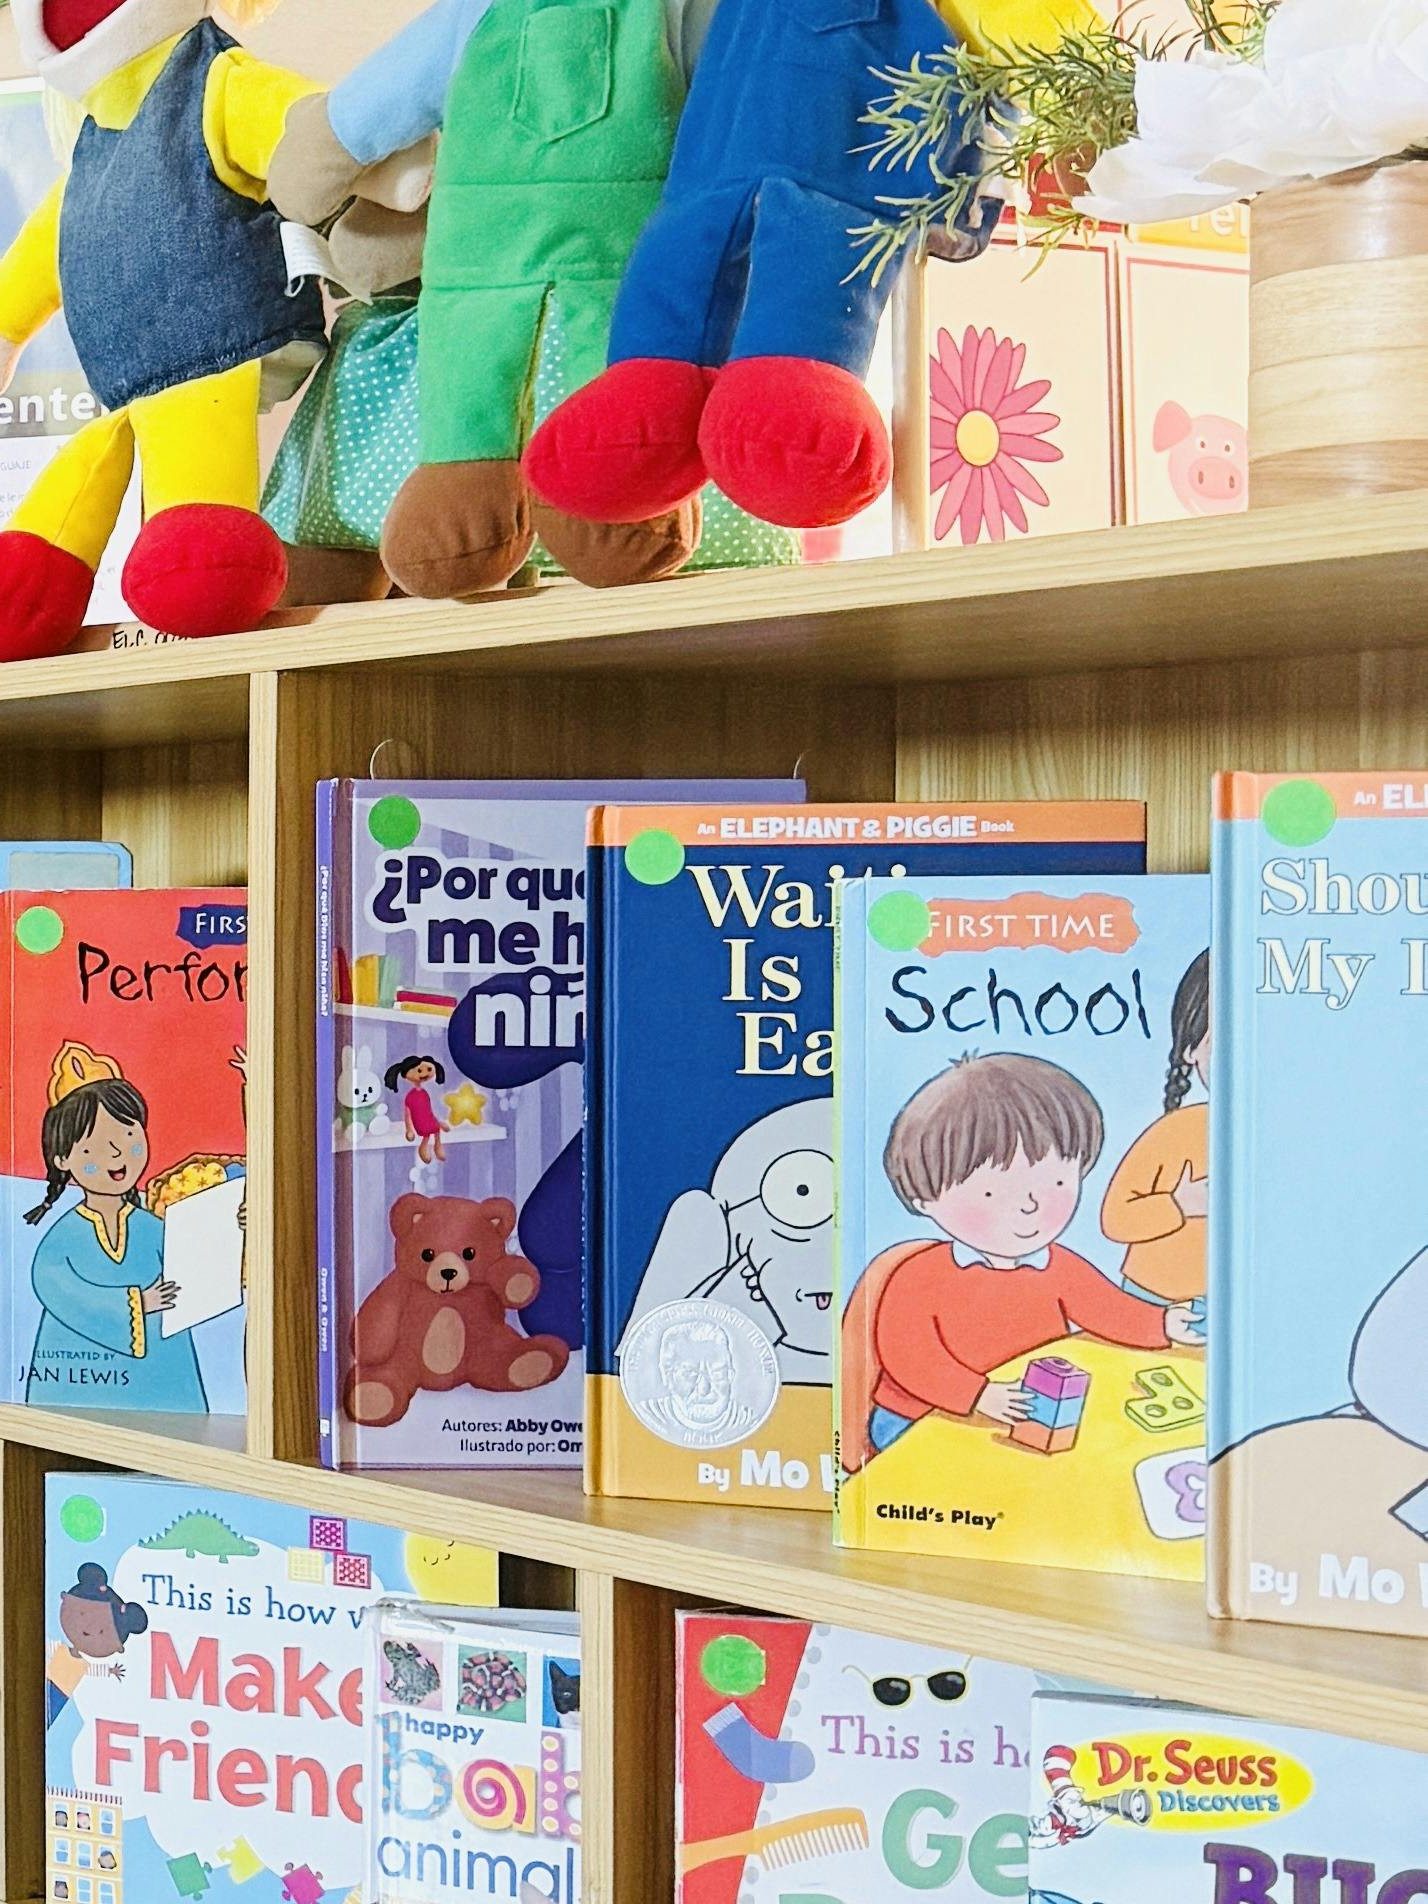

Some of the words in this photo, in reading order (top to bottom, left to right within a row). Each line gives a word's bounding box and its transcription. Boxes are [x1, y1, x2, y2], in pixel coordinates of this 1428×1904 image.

[1353, 791, 1377, 805] An
[1382, 783, 1428, 810] EL
[698, 823, 715, 835] An
[720, 818, 860, 839] ELEPHANT
[862, 819, 881, 839] &
[887, 816, 977, 837] PIGGIE
[981, 821, 1015, 832] Book
[373, 856, 496, 924] ¿Por
[685, 863, 907, 928] Wai
[429, 917, 540, 964] me
[928, 911, 1017, 938] FIRST
[1025, 914, 1114, 938] TIME
[722, 938, 802, 1002] Is
[1256, 937, 1376, 1010] My
[885, 966, 1150, 1039] School
[19, 1366, 60, 1382] JAN
[70, 1368, 130, 1385] LEWIS
[442, 1419, 502, 1433] Autores:
[506, 1419, 547, 1437] Abby
[460, 1439, 523, 1453] Ilustrado
[527, 1441, 555, 1456] por:
[699, 1463, 730, 1491] By
[741, 1449, 810, 1489] Mo
[876, 1504, 944, 1523] Child's
[142, 1573, 212, 1613] This
[226, 1592, 252, 1617] is
[265, 1586, 337, 1625] how
[1249, 1562, 1299, 1606] By
[1319, 1552, 1405, 1604] Mo
[405, 1711, 485, 1747] happy
[821, 1715, 920, 1761] This
[939, 1729, 975, 1765] is
[1092, 1741, 1158, 1787] Dr.
[1165, 1739, 1278, 1787] Seuss
[1156, 1790, 1280, 1812] Discovers
